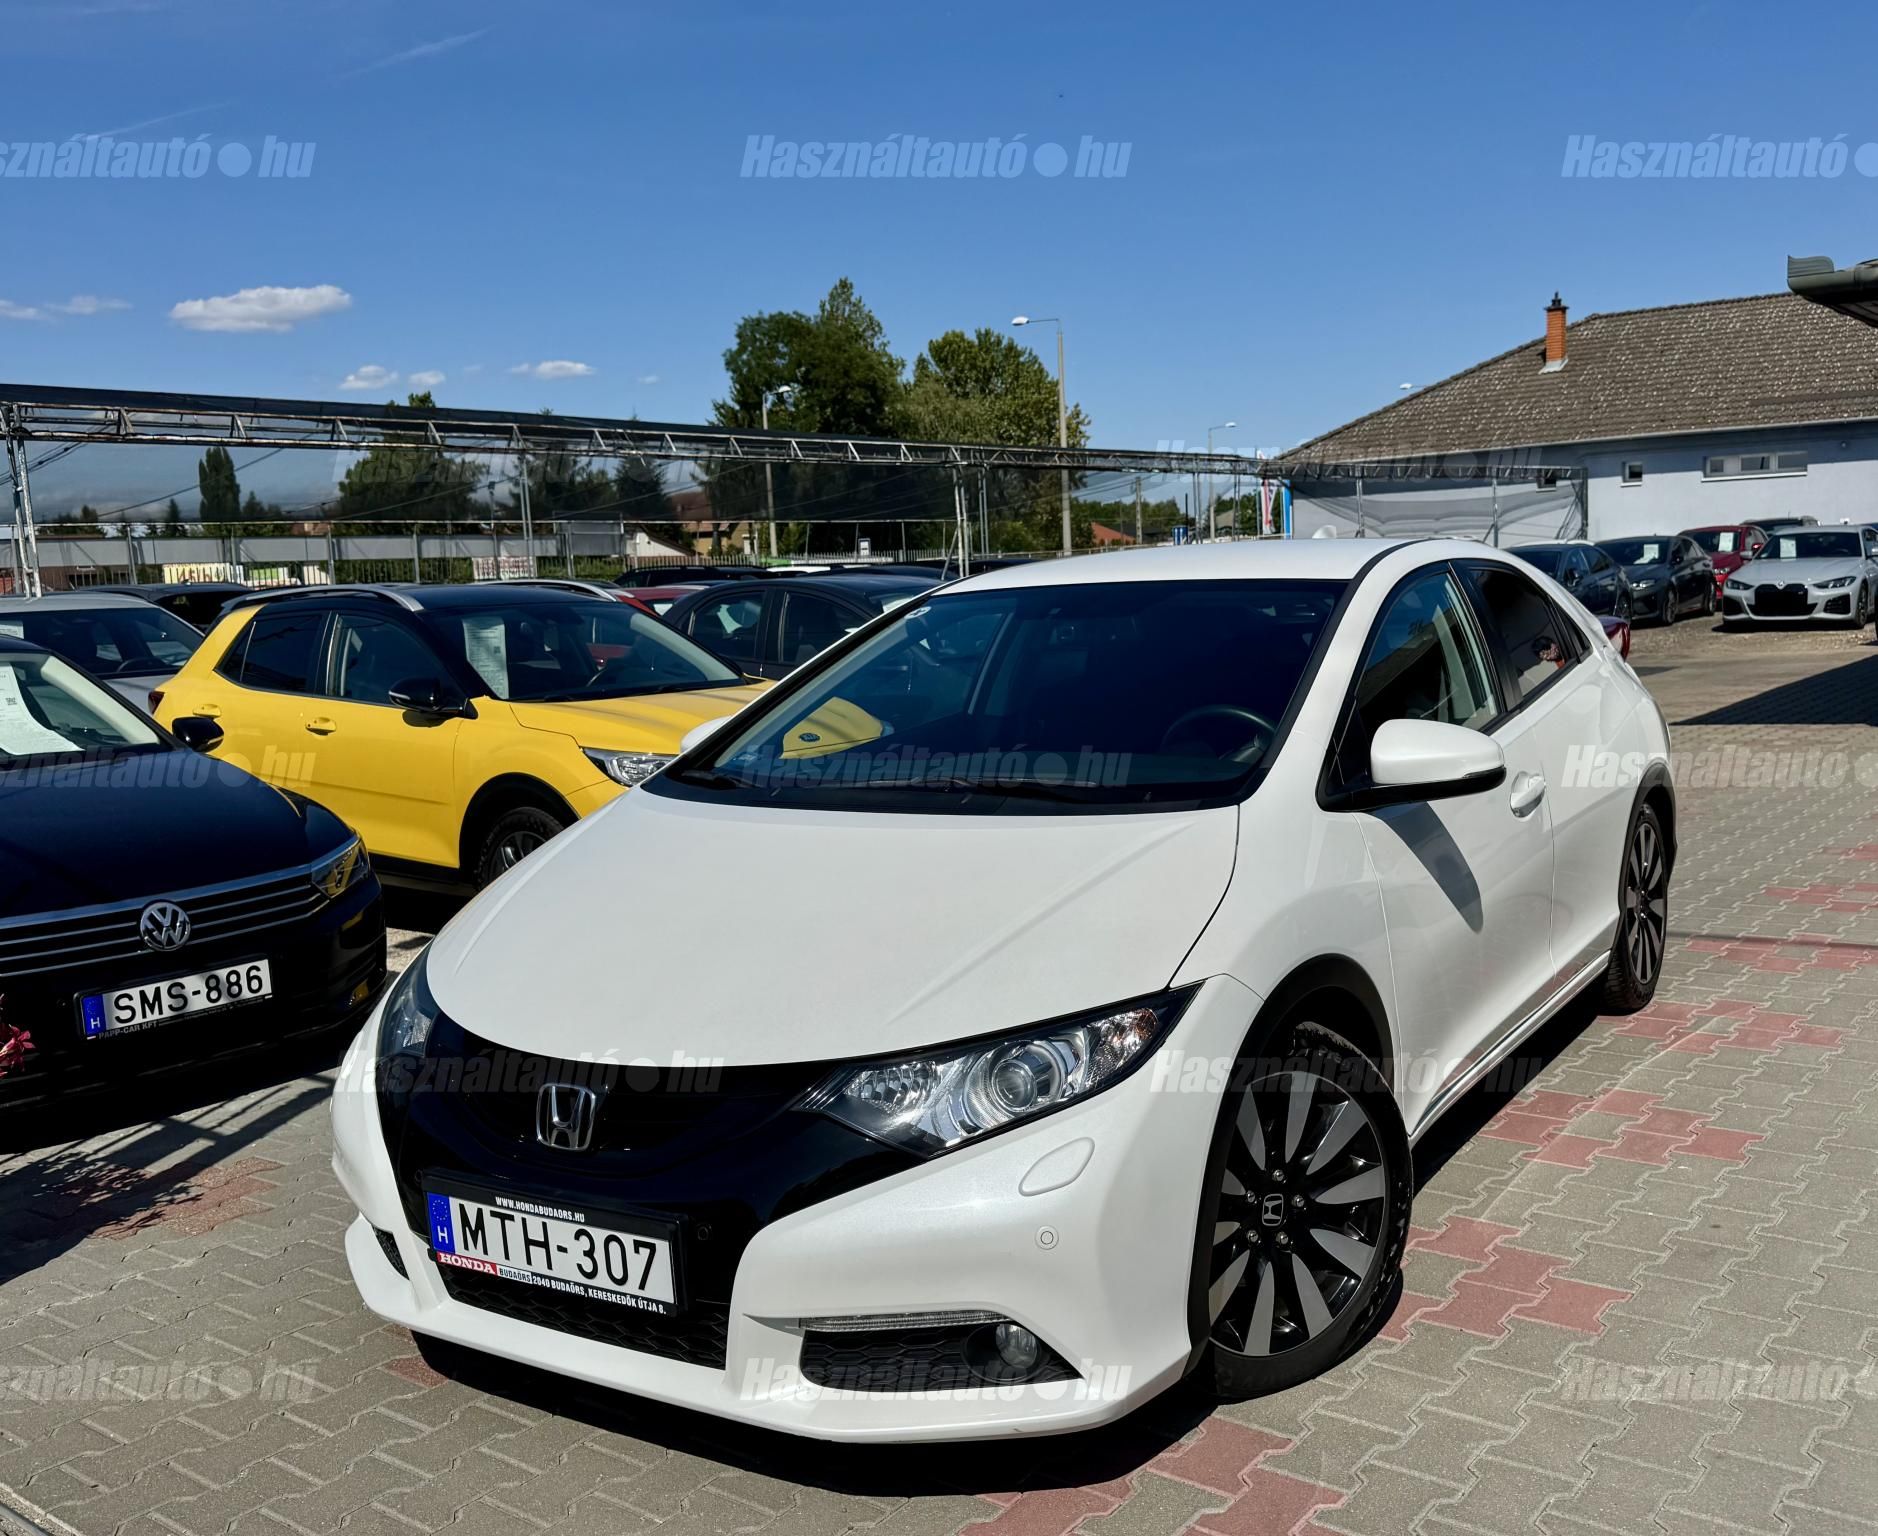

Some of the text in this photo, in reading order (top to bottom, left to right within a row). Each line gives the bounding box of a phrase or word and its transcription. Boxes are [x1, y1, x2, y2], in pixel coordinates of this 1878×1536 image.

[90, 1018, 100, 1029] H
[114, 965, 263, 1024] SMS-886
[99, 1024, 141, 1039] PAPP-CAR
[437, 1203, 657, 1291] H MTH-307
[439, 1252, 495, 1275] HONDA
